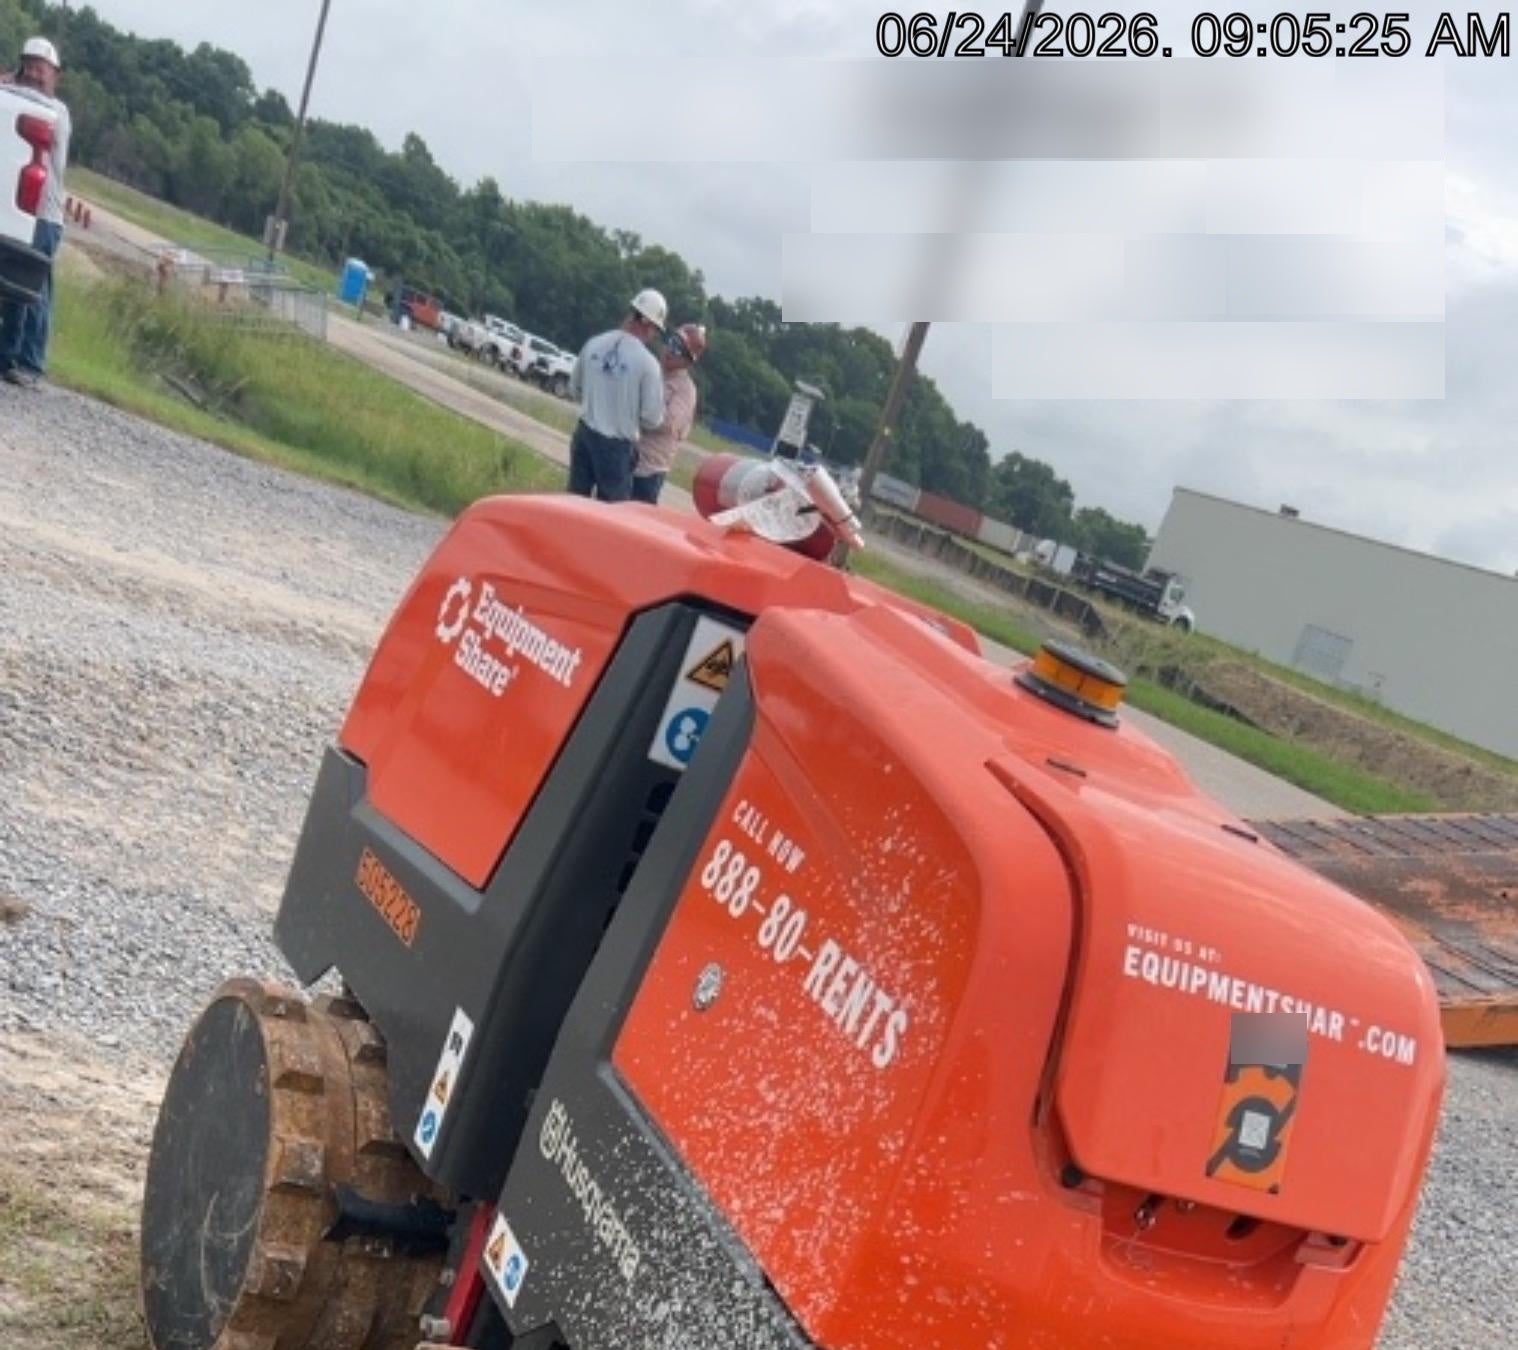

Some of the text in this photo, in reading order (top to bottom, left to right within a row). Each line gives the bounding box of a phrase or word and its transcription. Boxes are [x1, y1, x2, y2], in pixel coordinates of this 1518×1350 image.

[472, 581, 582, 688] Equipment
[732, 799, 805, 874] CALL NOW
[701, 839, 907, 1069] 888-80-RENTS
[1127, 923, 1168, 948] VISIT
[1174, 938, 1192, 955] US
[1123, 945, 1417, 1066] EQUIPMENTSHAR.COM
[555, 1119, 639, 1280] Husqvarna
